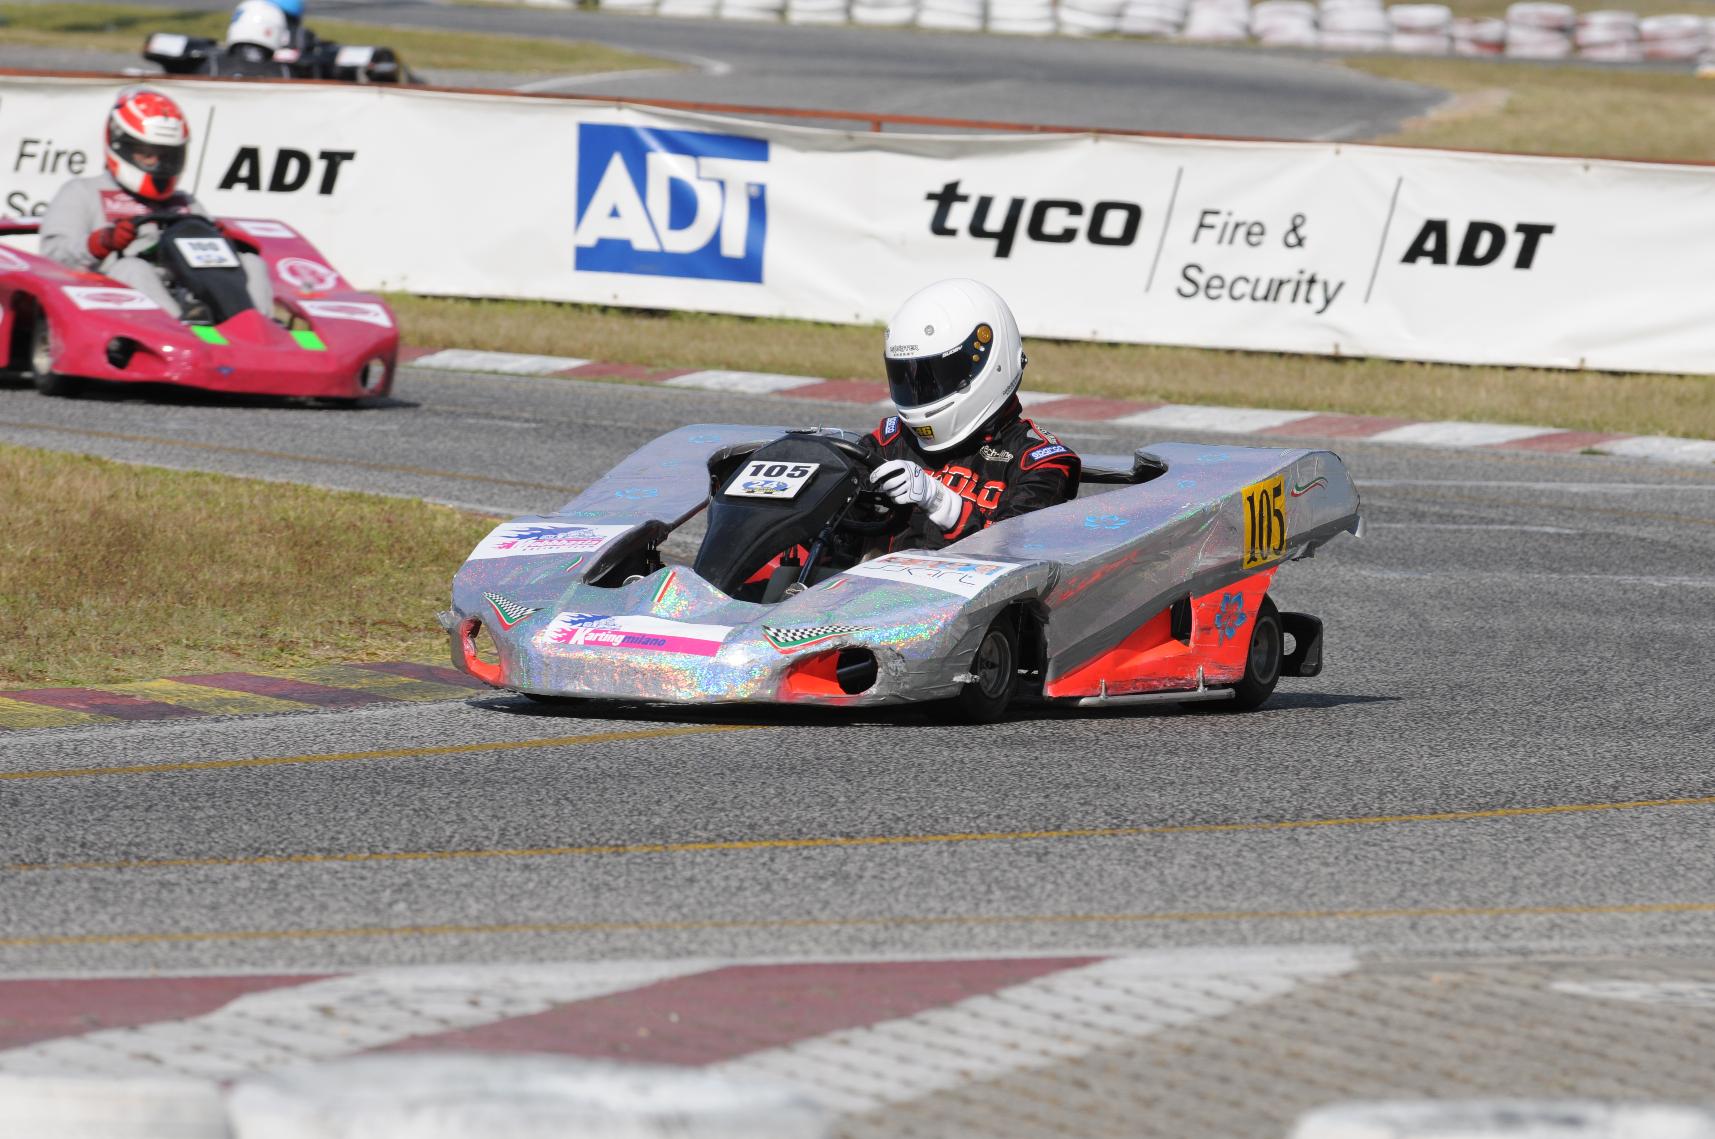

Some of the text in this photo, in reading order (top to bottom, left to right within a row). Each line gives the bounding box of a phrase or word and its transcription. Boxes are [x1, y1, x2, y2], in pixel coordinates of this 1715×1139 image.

[13, 138, 88, 175] Fire
[216, 146, 356, 196] ADT
[575, 150, 769, 260] ADT
[924, 179, 1143, 259] tyco
[1191, 209, 1308, 249] Fire &
[1400, 219, 1556, 270] ADT
[1176, 263, 1345, 315] Security
[749, 464, 811, 479] 105
[1247, 480, 1285, 564] 105
